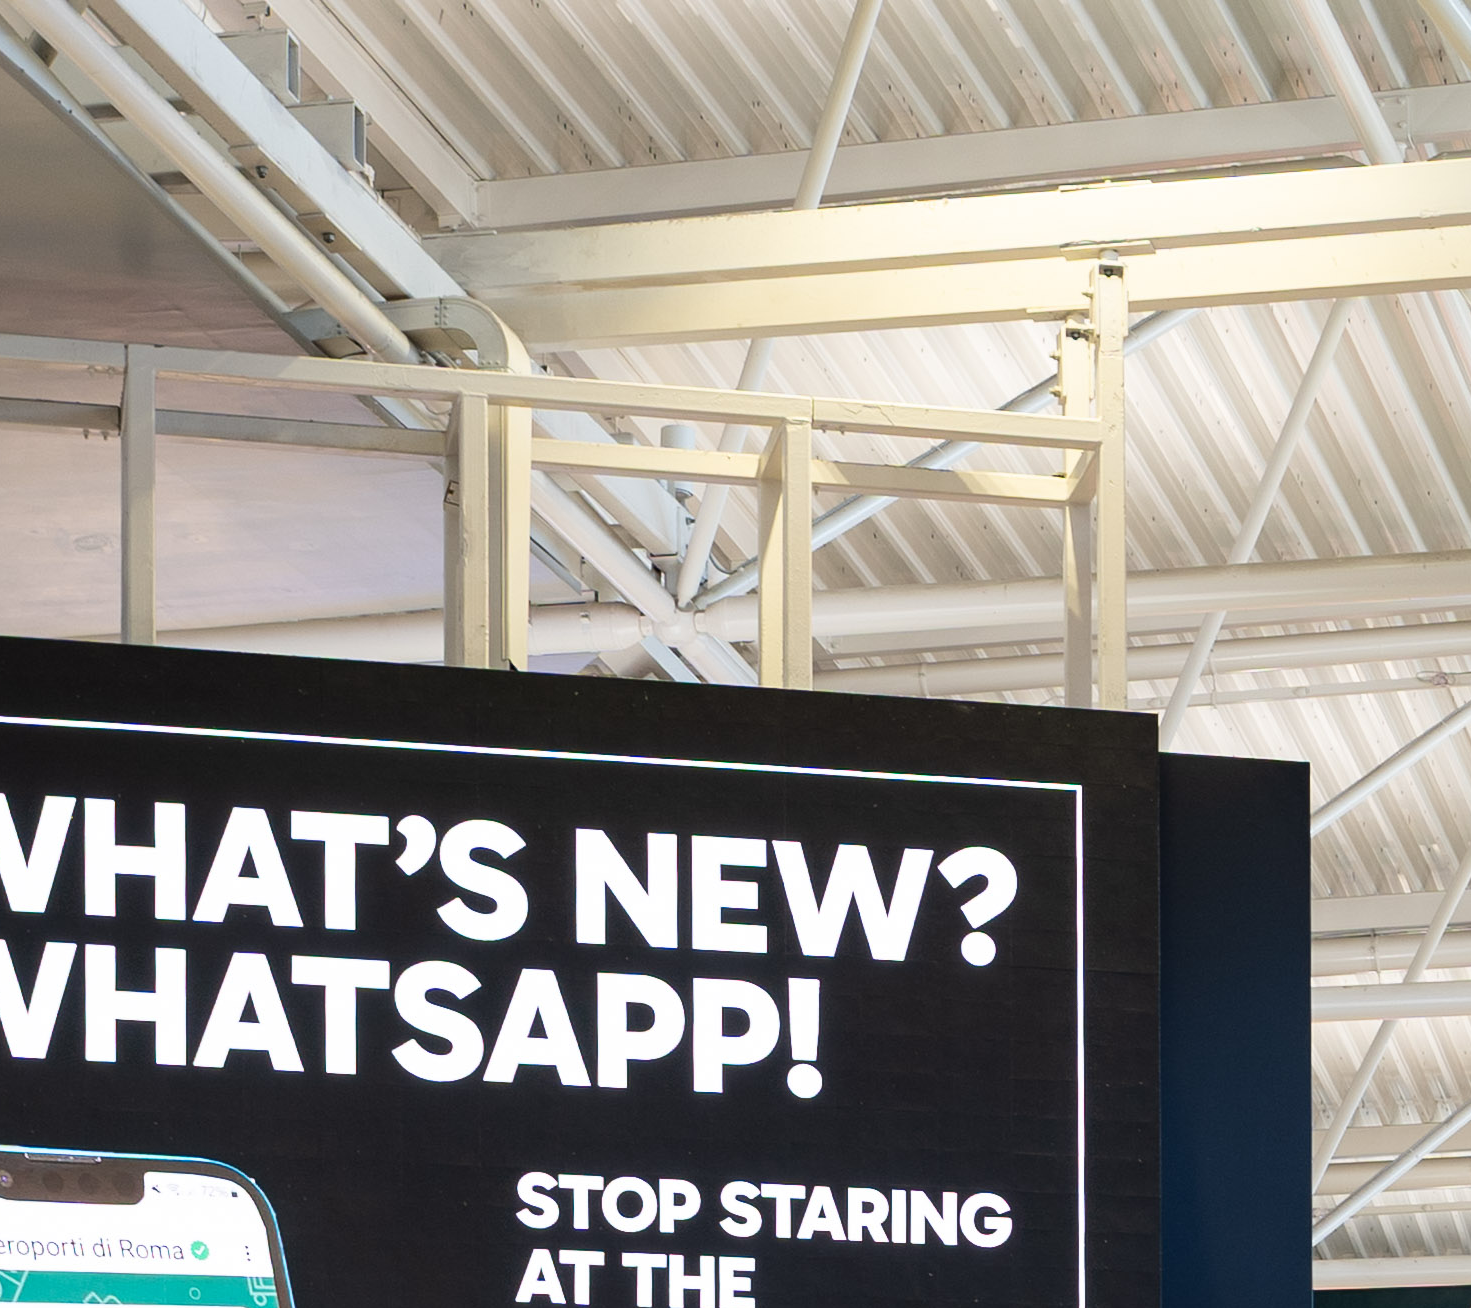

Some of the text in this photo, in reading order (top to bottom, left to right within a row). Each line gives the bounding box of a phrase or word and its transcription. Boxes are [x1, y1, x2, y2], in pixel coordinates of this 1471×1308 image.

[575, 826, 1018, 967] NEW?
[515, 1172, 1014, 1248] STOP STARING
[94, 1235, 113, 1259] di
[120, 1239, 185, 1261] Roma
[515, 1248, 605, 1306] AT
